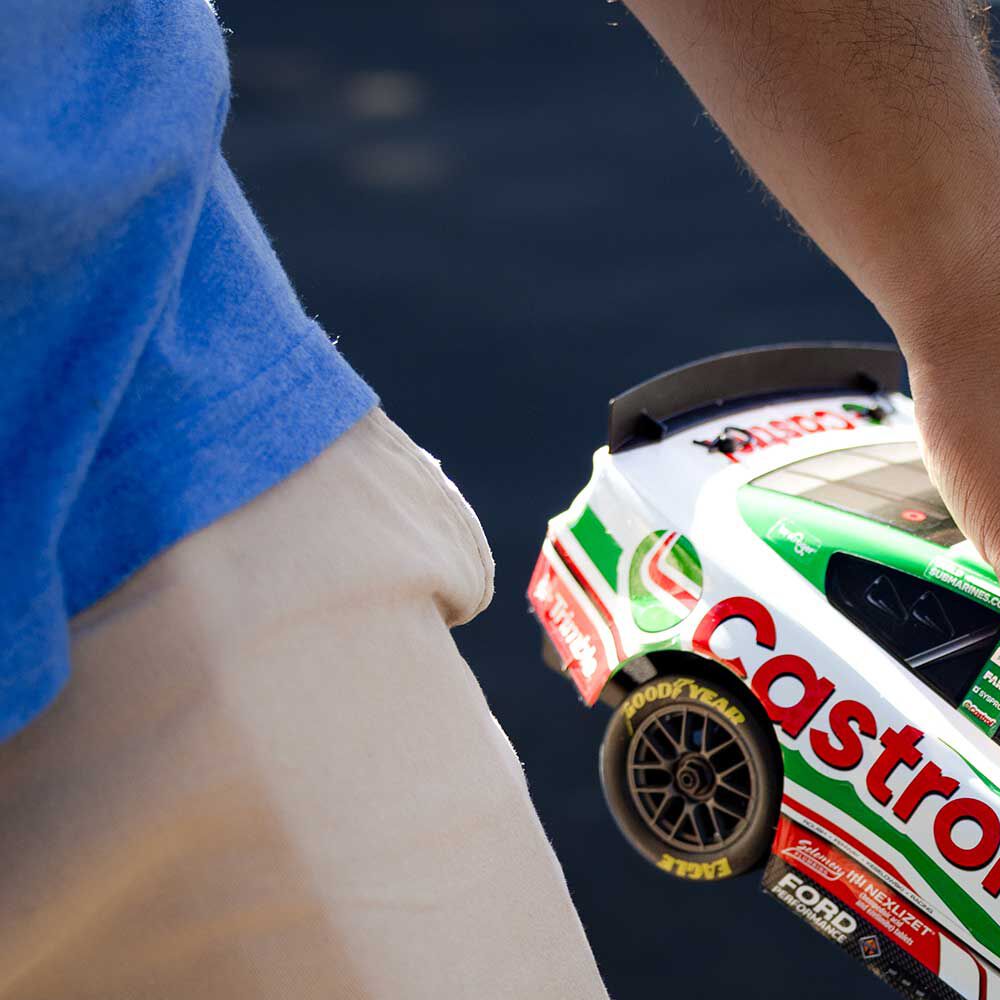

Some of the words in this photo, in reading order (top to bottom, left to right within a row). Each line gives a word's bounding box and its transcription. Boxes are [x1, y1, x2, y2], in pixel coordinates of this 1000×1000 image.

[621, 677, 746, 730] GOODYEAR
[656, 853, 733, 881] EAGLE
[771, 884, 848, 944] PERFORMANCE
[778, 872, 858, 934] FORD
